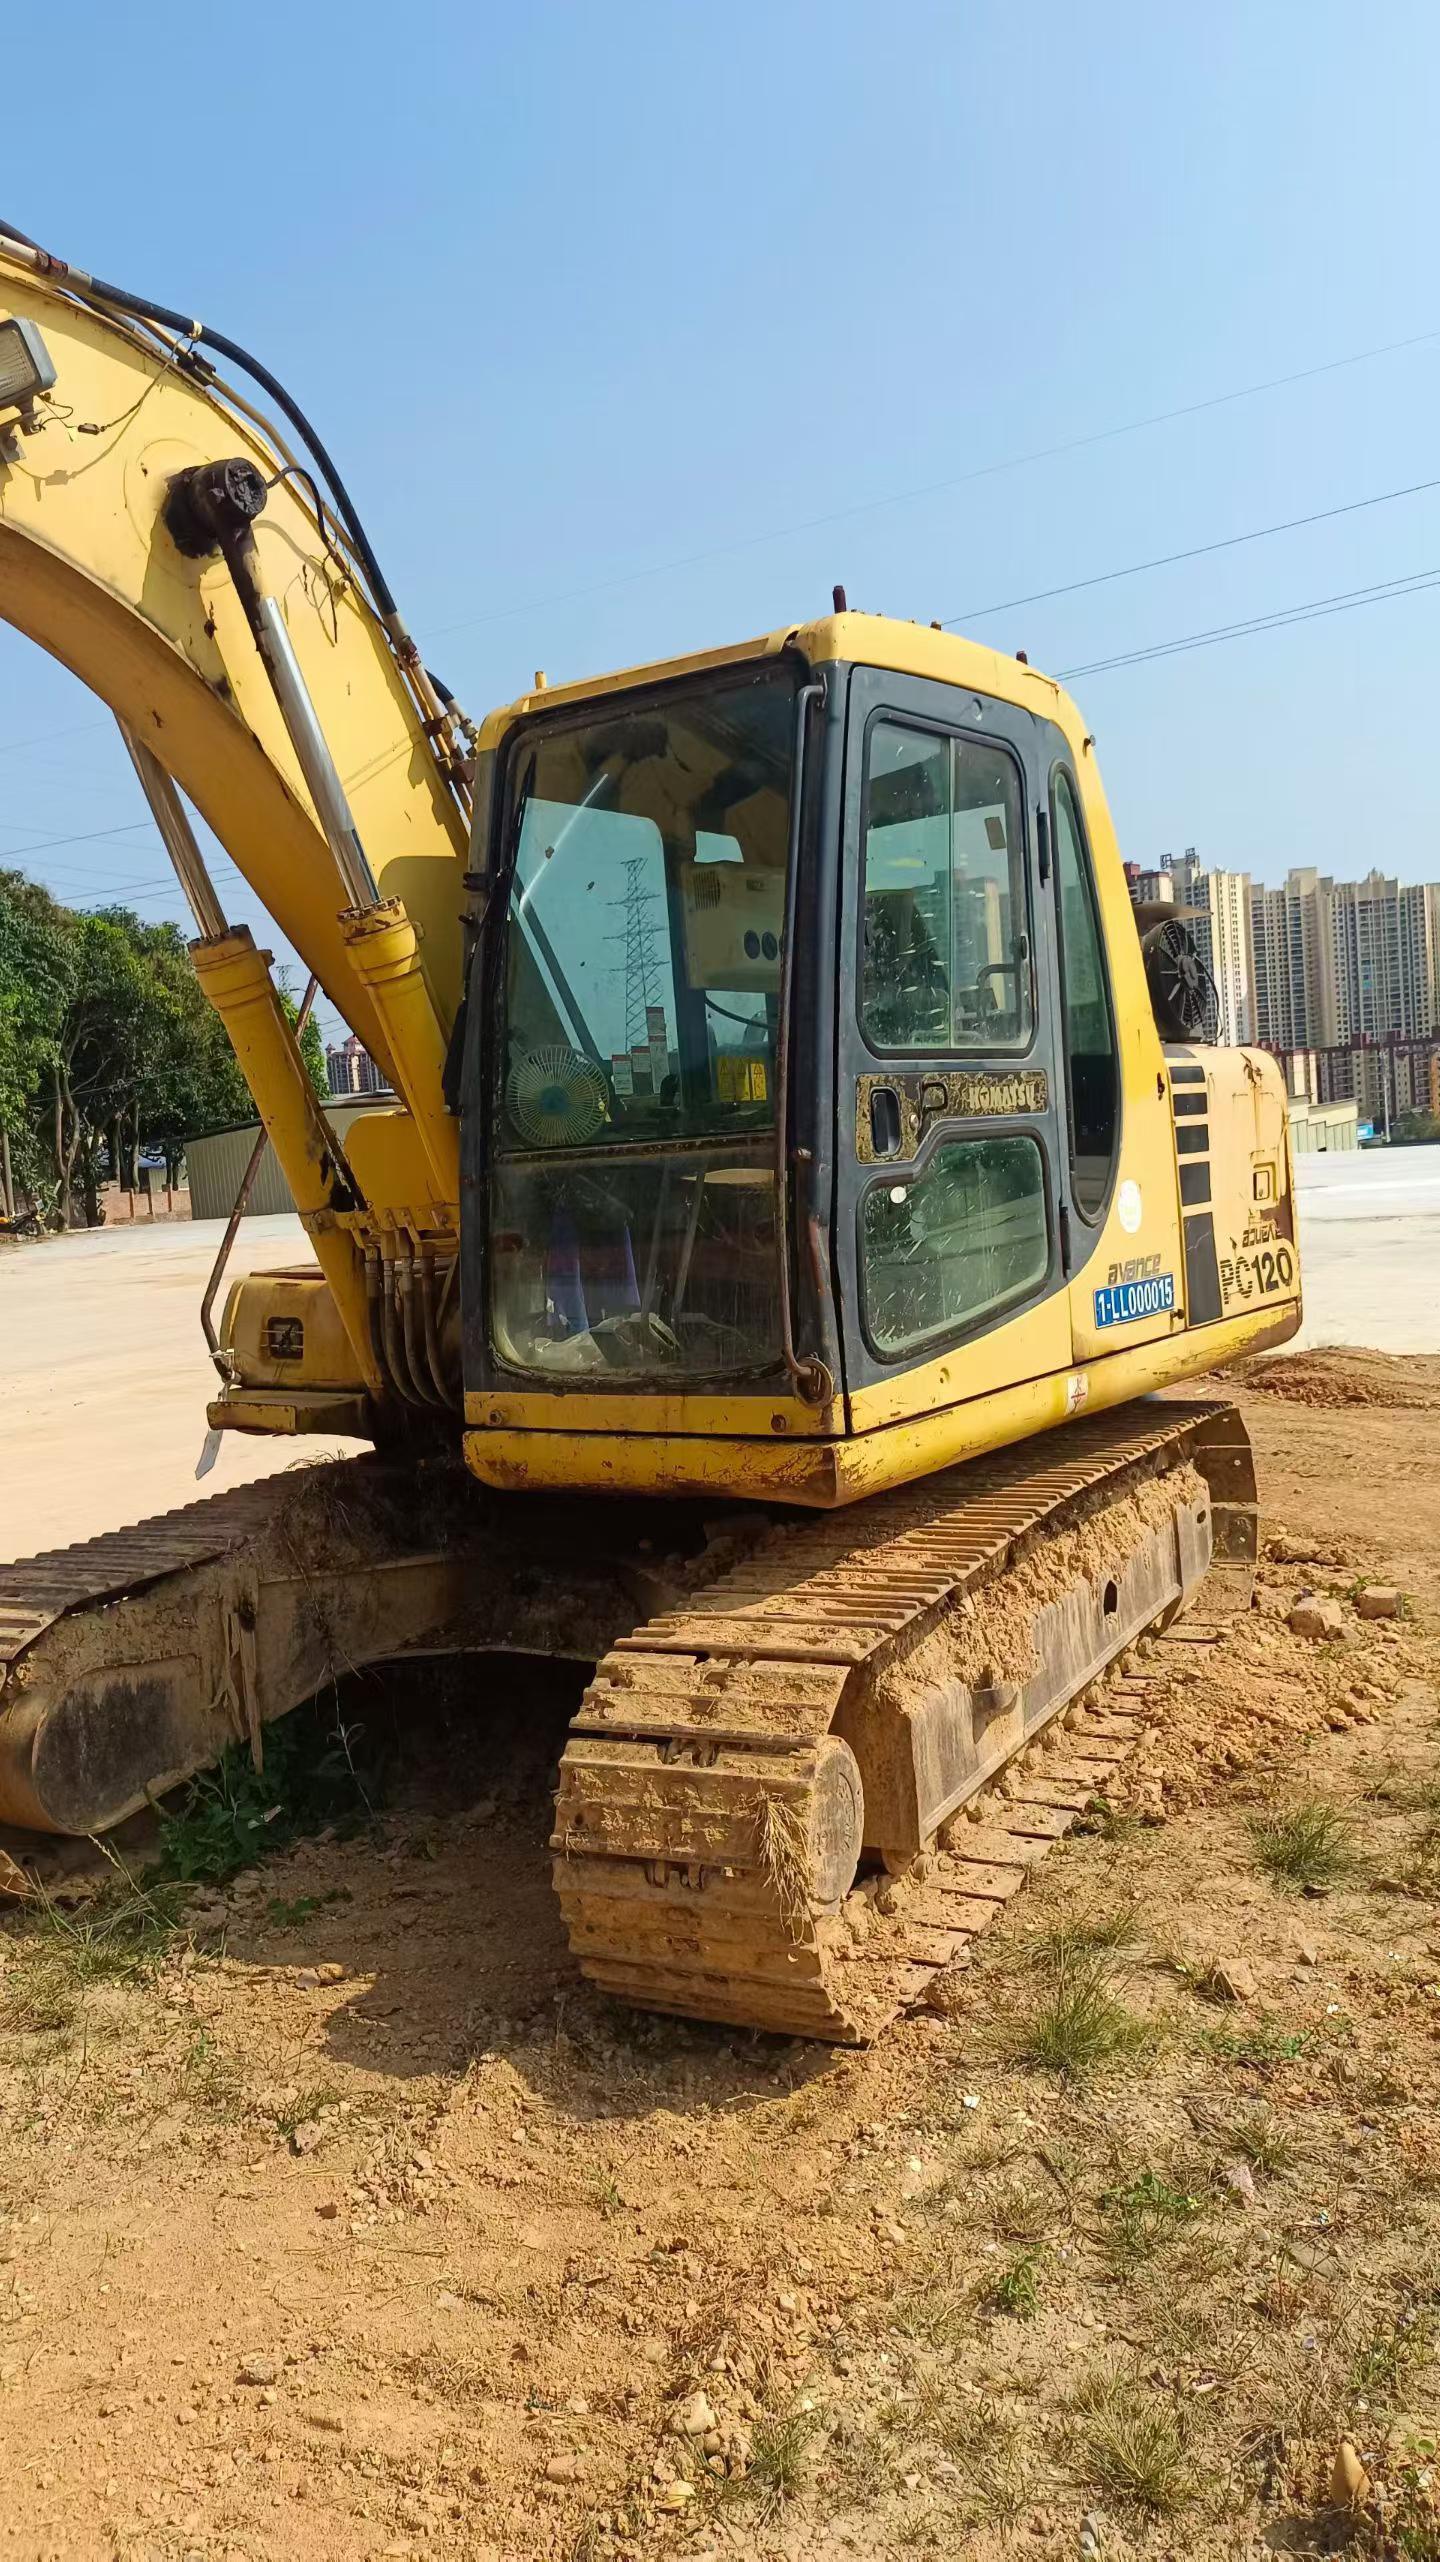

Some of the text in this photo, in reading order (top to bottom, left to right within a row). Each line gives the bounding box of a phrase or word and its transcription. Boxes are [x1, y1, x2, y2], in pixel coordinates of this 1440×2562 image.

[969, 1081, 1036, 1110] KOMATSU
[1107, 1253, 1161, 1285] avance
[1220, 1247, 1293, 1305] PC120
[1098, 1277, 1172, 1322] 1-LL000015
